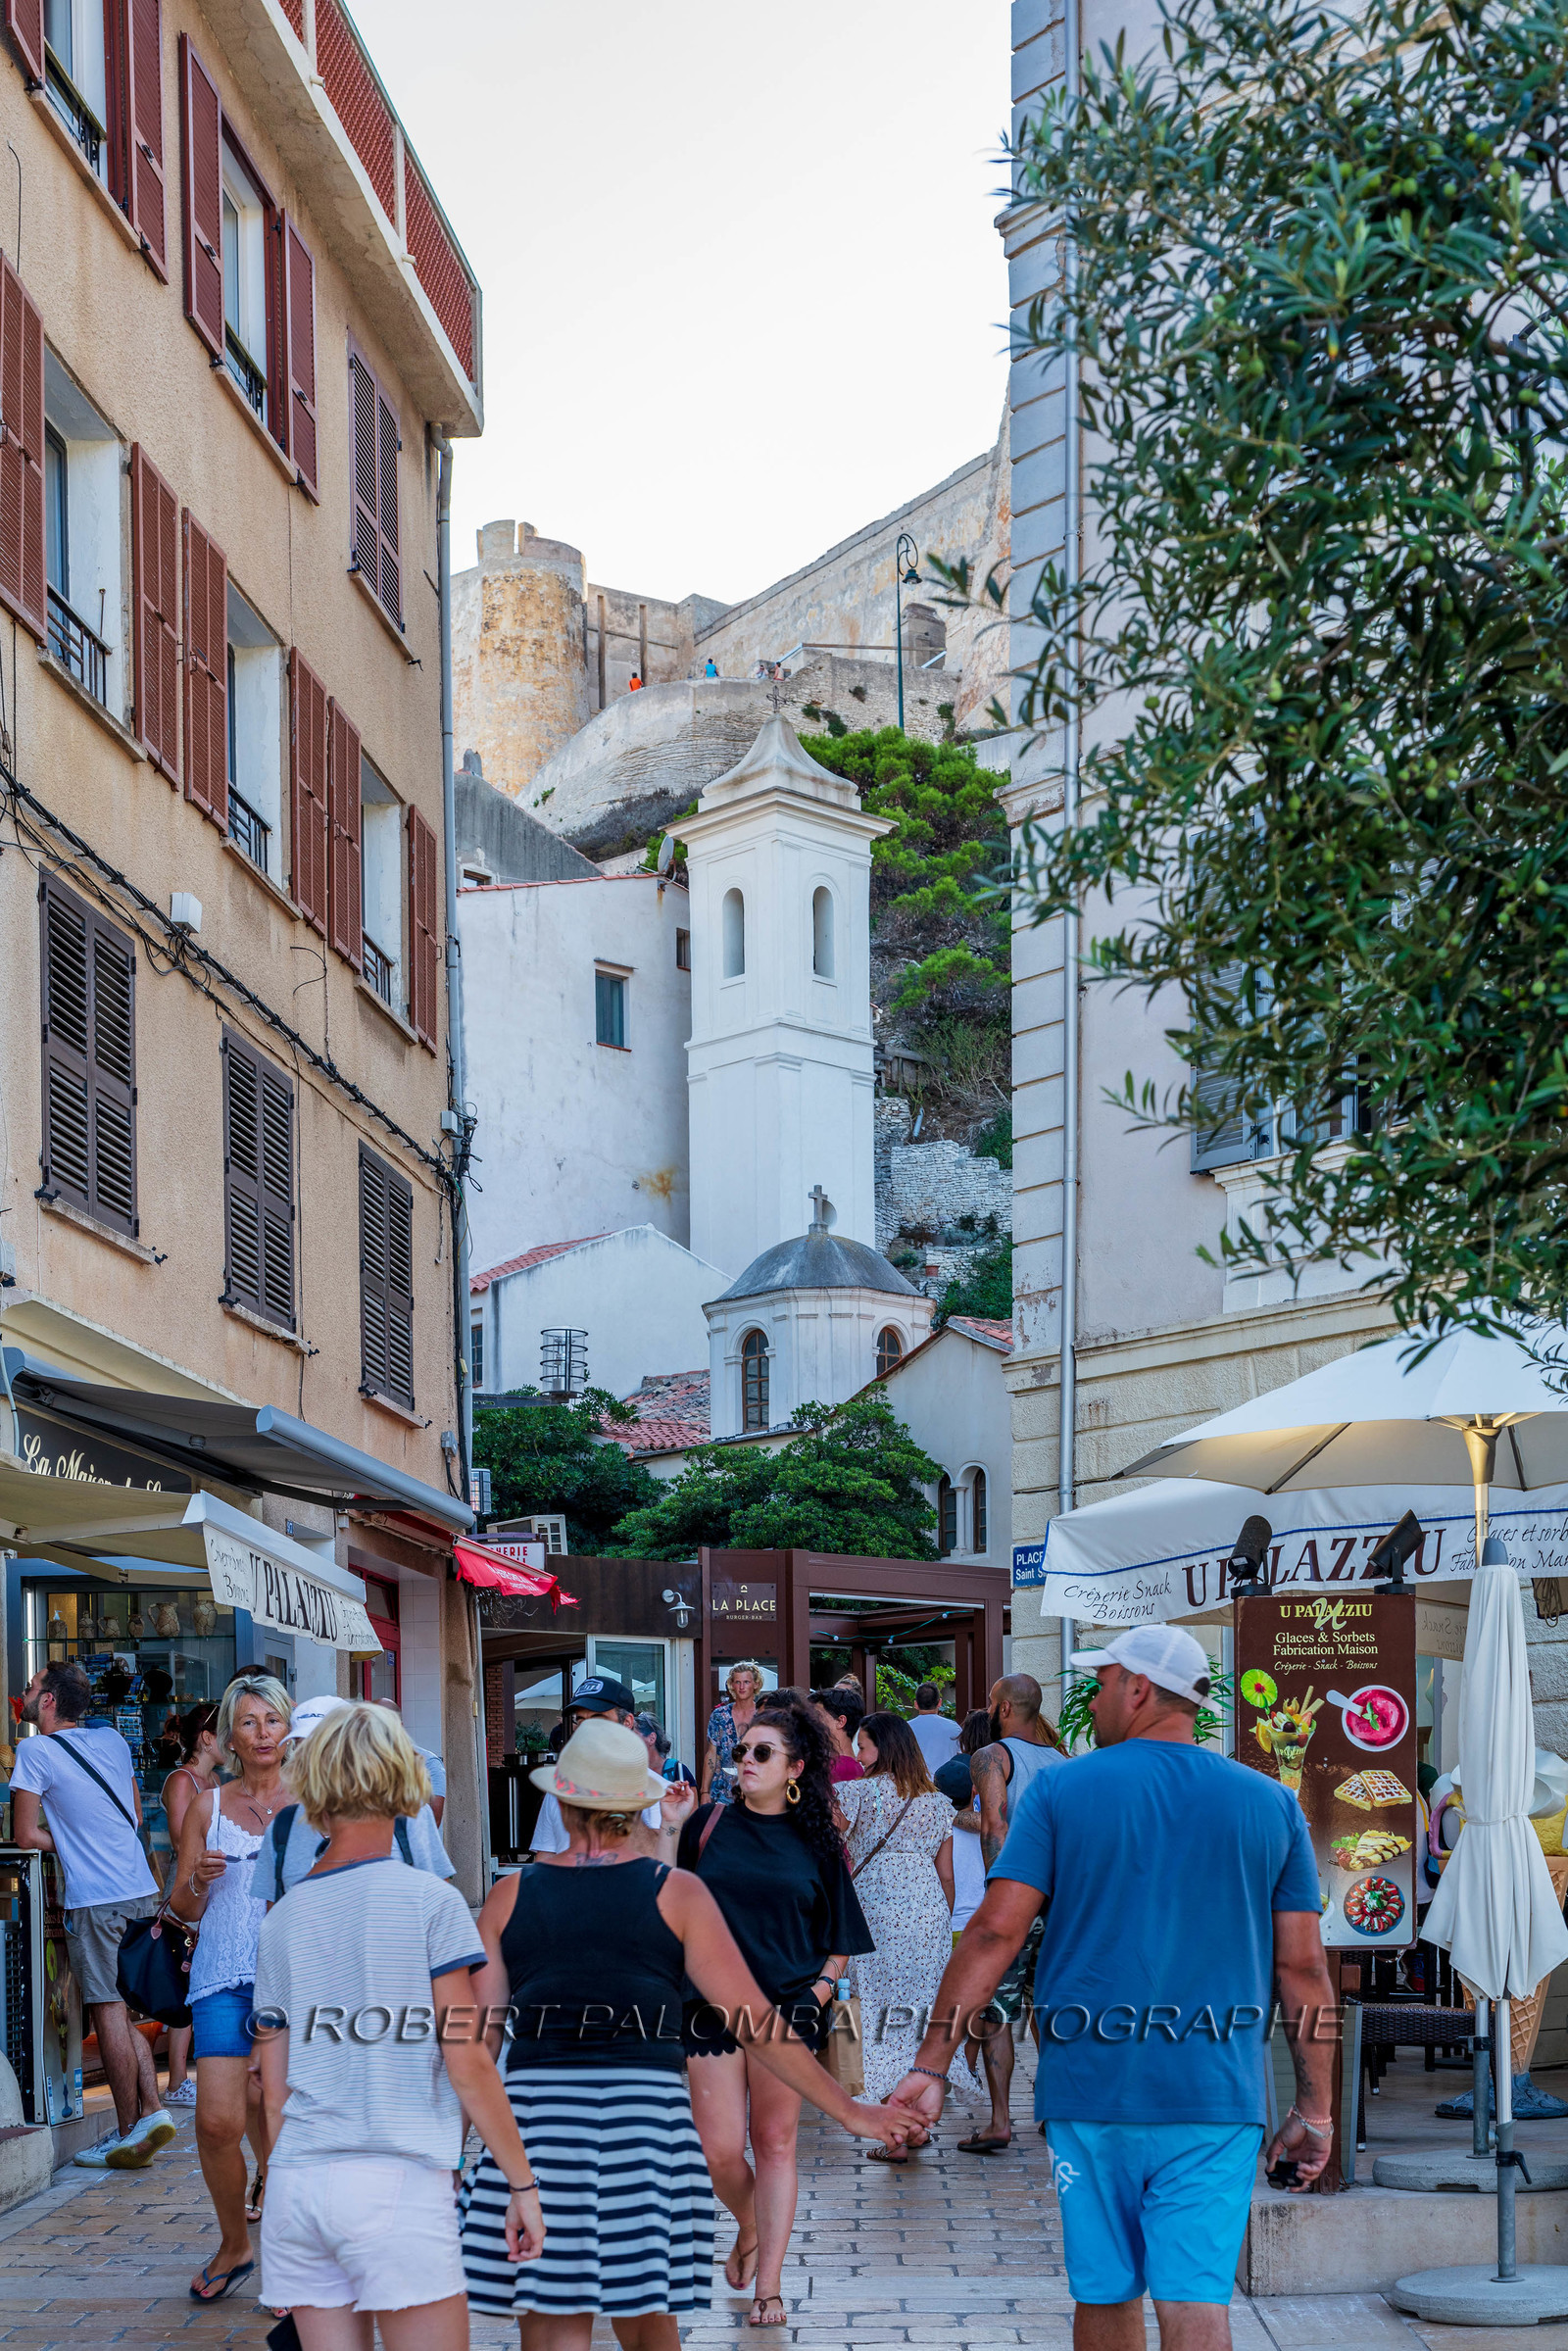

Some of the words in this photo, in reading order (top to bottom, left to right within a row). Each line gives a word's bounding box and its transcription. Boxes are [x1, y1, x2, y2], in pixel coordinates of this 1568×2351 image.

[1522, 1524, 1537, 1542] et
[491, 1545, 527, 1556] HERIE
[1015, 1568, 1035, 1581] Saint
[1063, 1582, 1130, 1608] Crêperie
[1133, 1571, 1172, 1599] Snack
[1182, 1562, 1210, 1607] U
[712, 1599, 729, 1611] LA
[736, 1599, 776, 1611] PLACE
[1093, 1602, 1154, 1619] Boissons
[1280, 1605, 1292, 1618] U
[1276, 1633, 1314, 1643] Glaces
[1318, 1632, 1329, 1643] &
[1333, 1632, 1376, 1643] Sorbets
[1273, 1644, 1335, 1656] Fabrication
[1338, 1643, 1379, 1655] Maison
